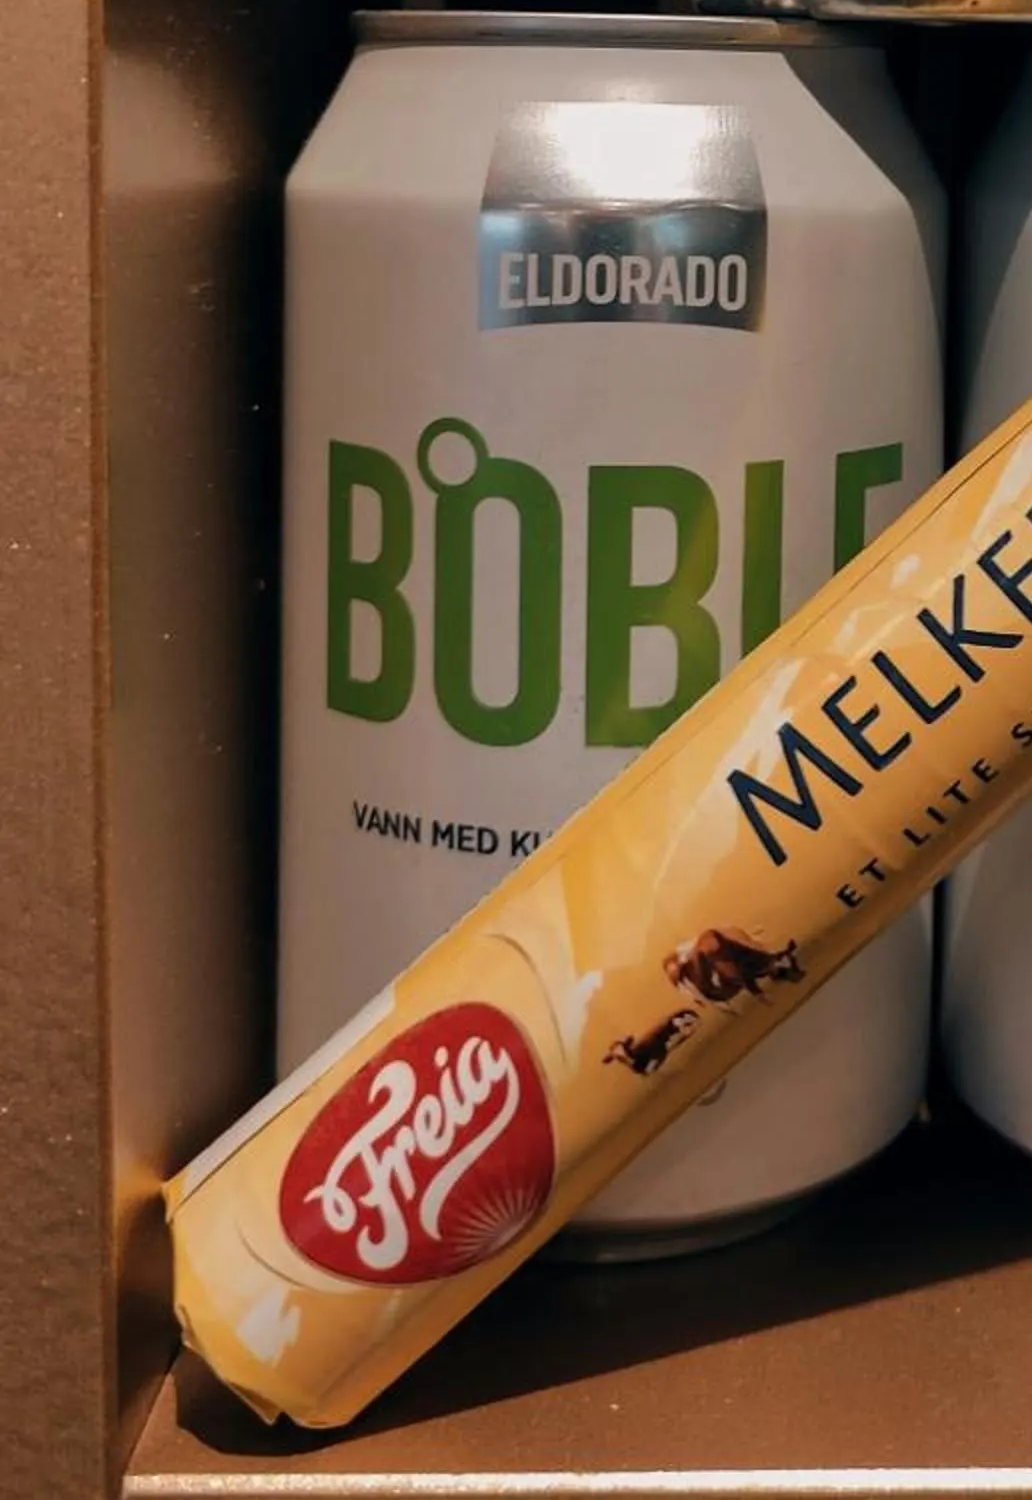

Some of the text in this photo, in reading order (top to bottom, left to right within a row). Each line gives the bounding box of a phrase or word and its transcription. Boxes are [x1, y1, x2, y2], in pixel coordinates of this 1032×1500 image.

[498, 250, 748, 312] ELDORADO
[353, 799, 421, 843] VANN
[431, 819, 498, 855] MED
[836, 857, 887, 909] ET
[902, 757, 999, 848] LITE
[304, 1035, 520, 1270] Freia
